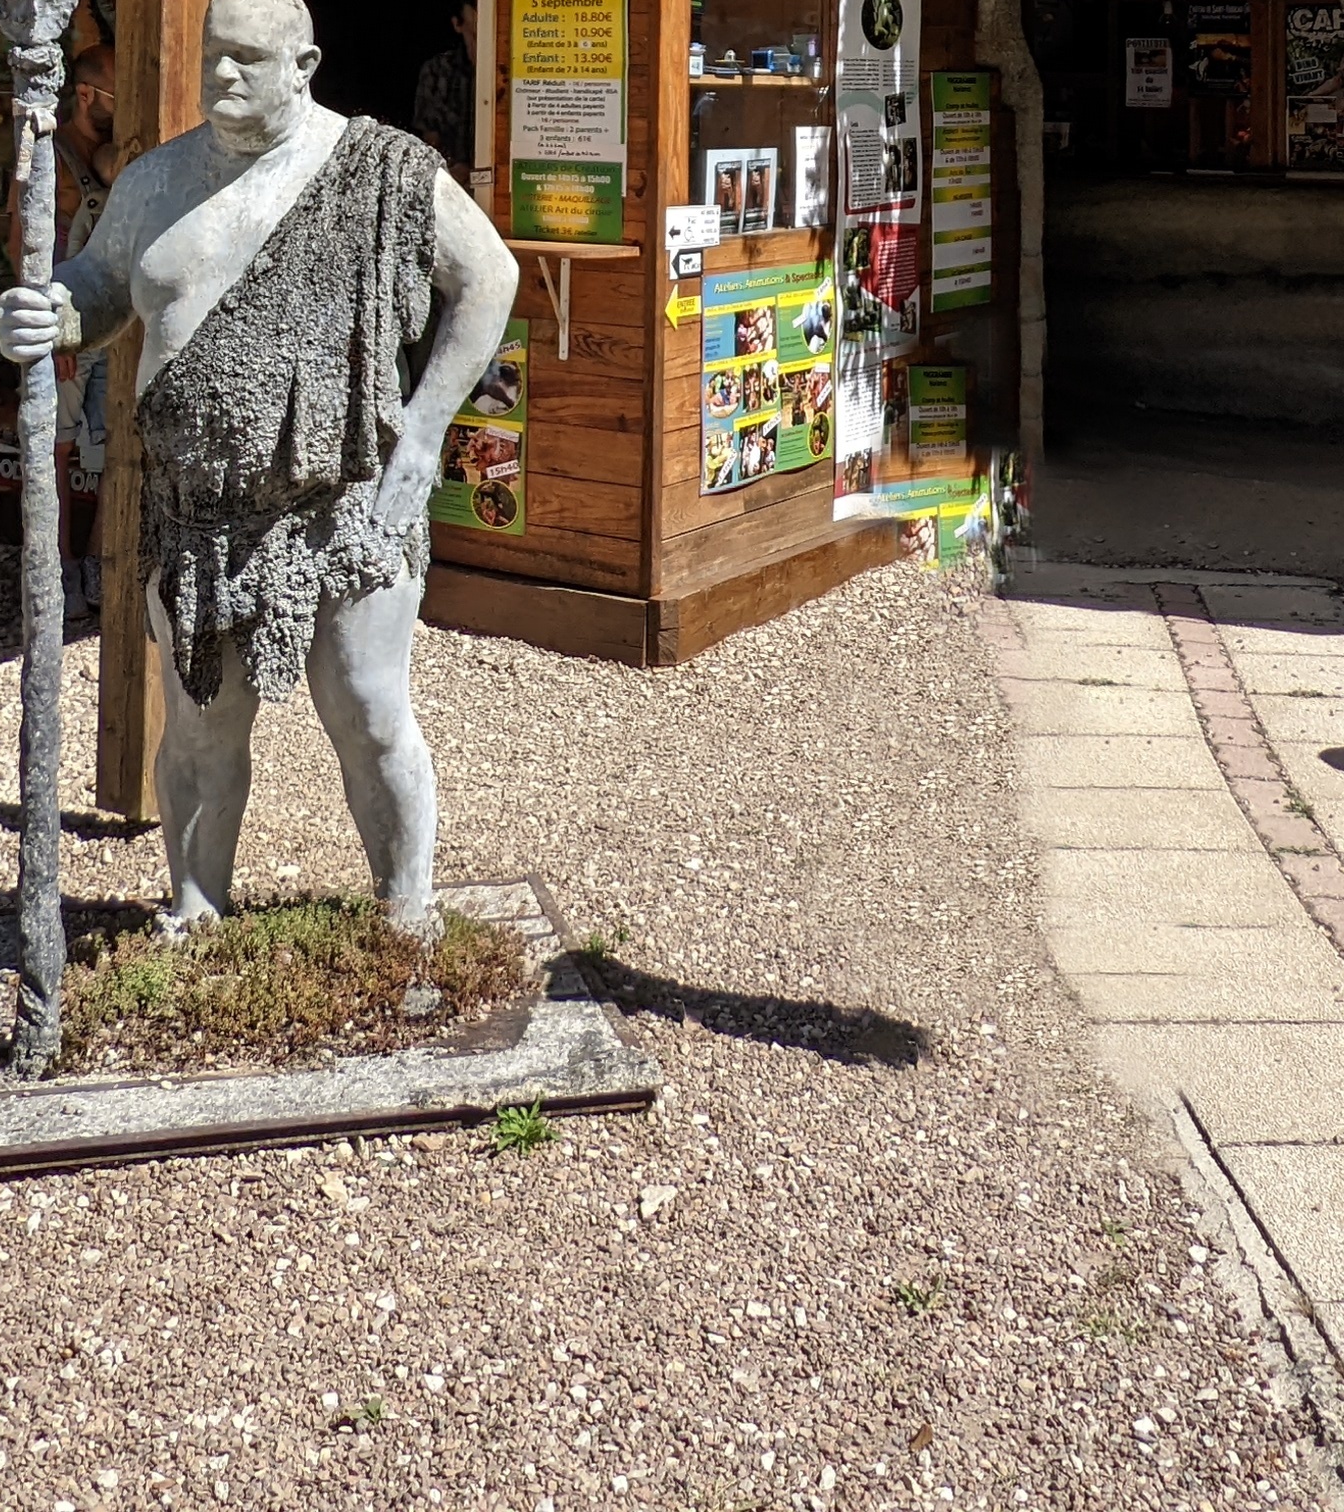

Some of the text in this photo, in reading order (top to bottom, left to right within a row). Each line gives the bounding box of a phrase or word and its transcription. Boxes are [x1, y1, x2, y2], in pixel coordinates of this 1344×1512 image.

[522, 11, 613, 23] Adulte 18.80€
[522, 27, 613, 38] Enfant 10.90€
[555, 40, 566, 48] de
[522, 52, 613, 64] Enfant 13.90€
[555, 66, 566, 74] de
[581, 66, 590, 74] 14
[521, 172, 546, 181] Ouvert
[555, 206, 568, 214] Art
[570, 206, 583, 215] du
[534, 225, 561, 235] Ticket
